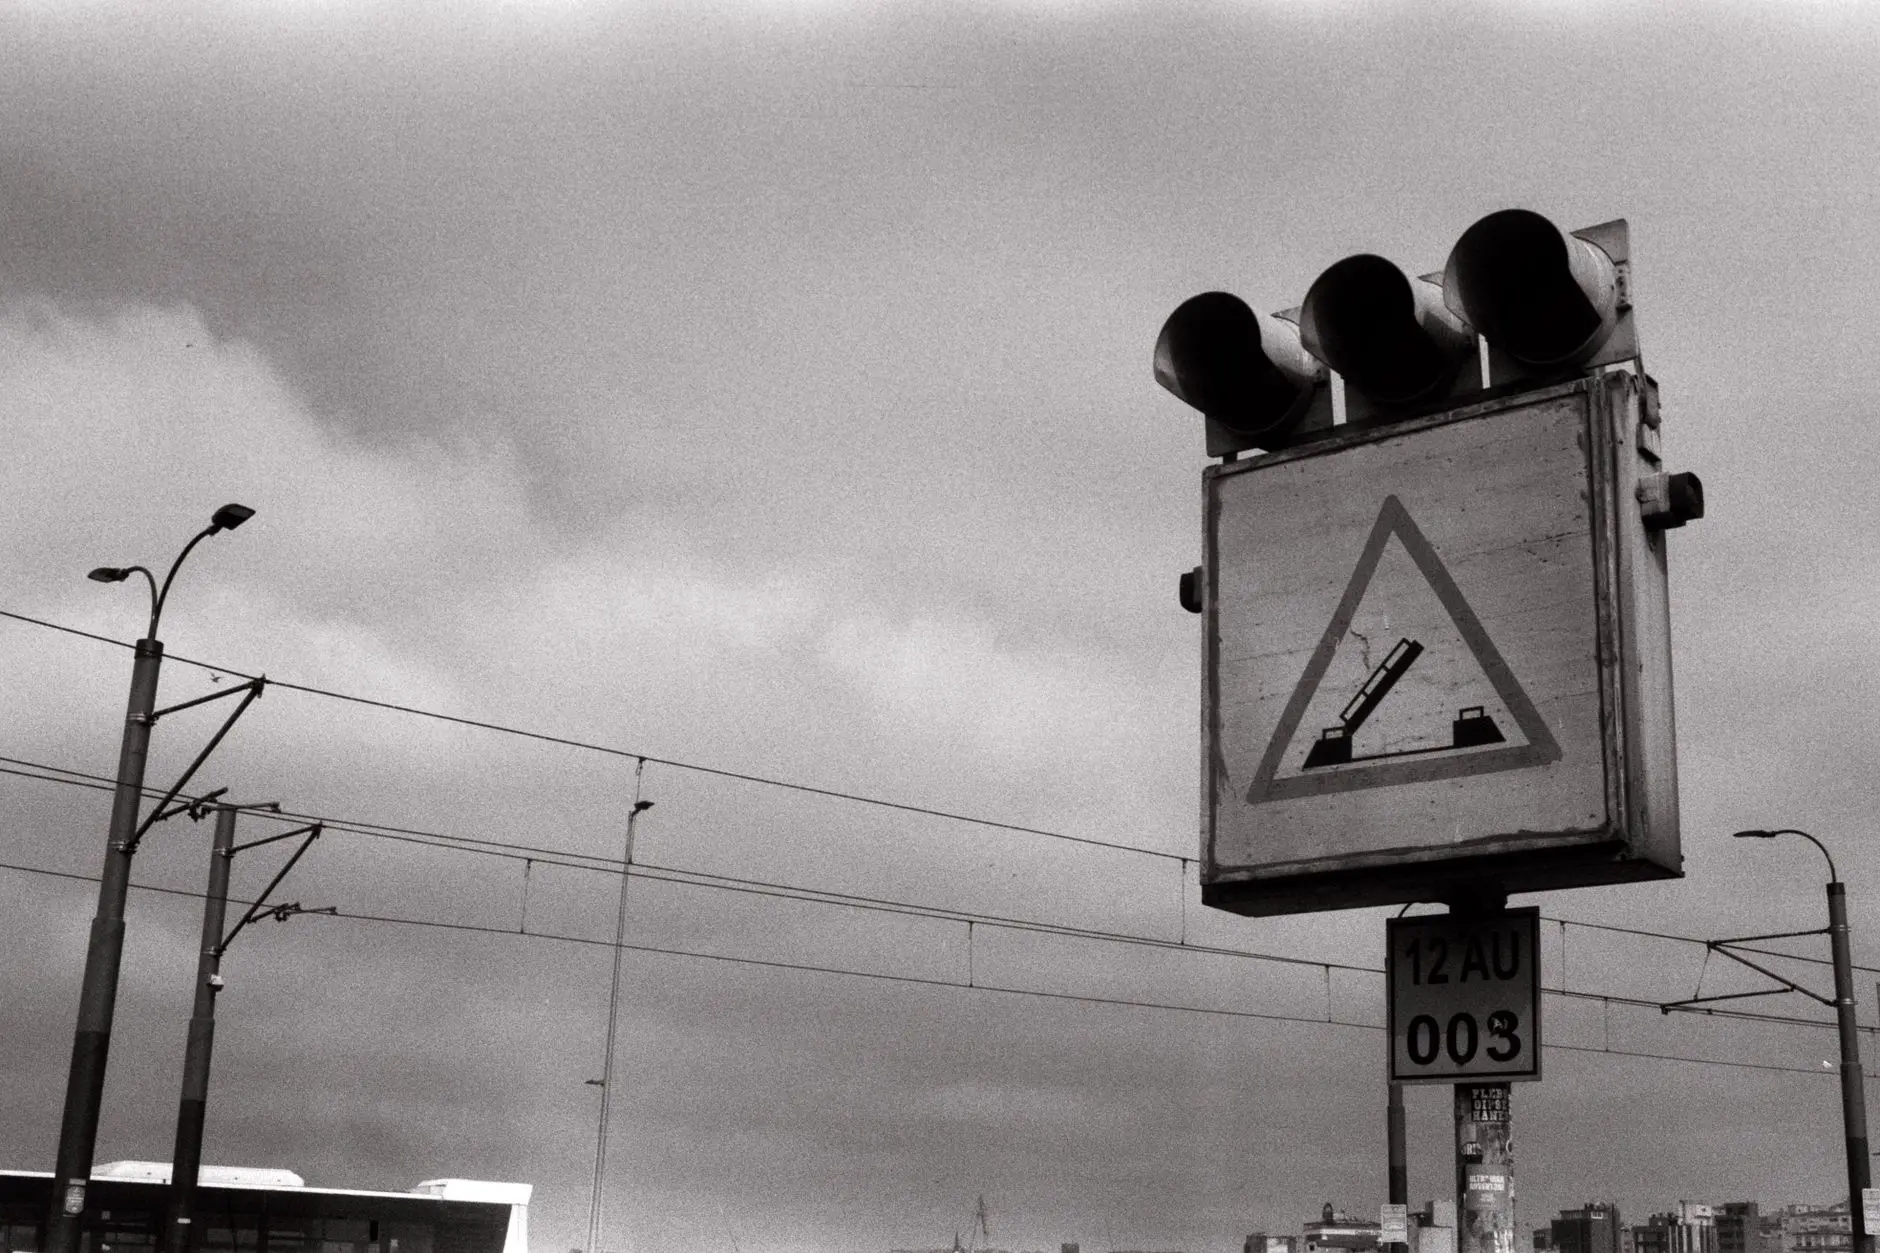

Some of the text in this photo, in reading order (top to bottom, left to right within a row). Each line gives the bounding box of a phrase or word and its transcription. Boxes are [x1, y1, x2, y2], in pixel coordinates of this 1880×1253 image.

[1405, 931, 1520, 986] 12 AU
[1406, 1010, 1522, 1066] 003
